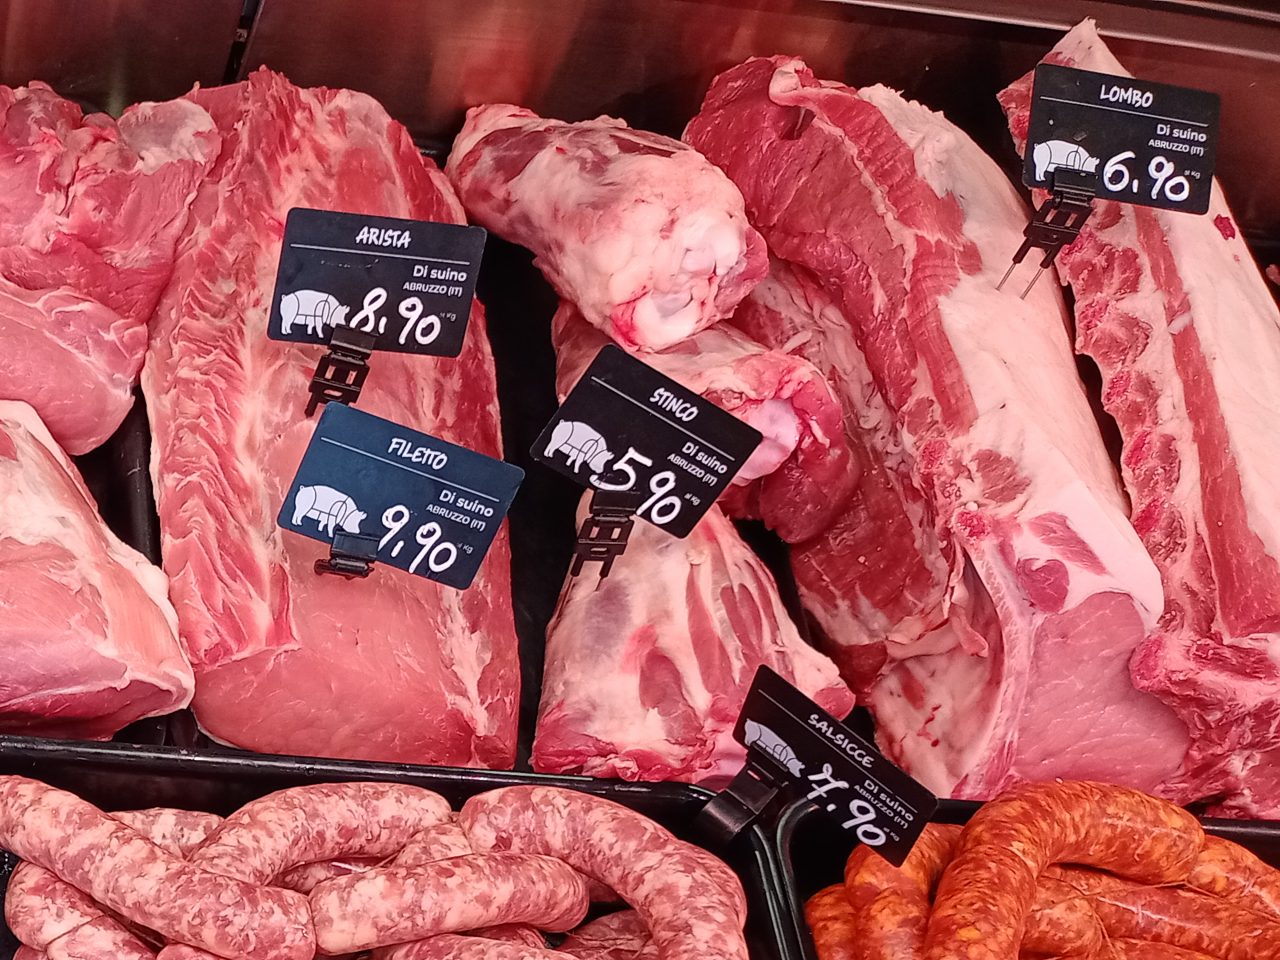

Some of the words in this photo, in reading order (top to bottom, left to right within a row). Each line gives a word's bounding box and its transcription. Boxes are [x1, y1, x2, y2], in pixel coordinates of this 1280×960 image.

[1099, 84, 1154, 108] LOMBO
[1148, 139, 1190, 153] ABRUZZO
[1190, 144, 1205, 157] (IT)
[1156, 124, 1171, 136] Di
[1172, 127, 1207, 143] suino
[355, 225, 412, 249] ARISTA
[413, 264, 428, 278] Di
[429, 266, 468, 282] suino
[402, 282, 448, 295] ABRUZZO
[448, 285, 463, 298] (IT)
[649, 387, 699, 423] STINCO
[387, 437, 448, 470] FILETTO
[682, 441, 701, 458] Di
[695, 450, 728, 475] suino
[667, 453, 704, 479] ABRUZZO
[702, 474, 718, 487] (IT)
[425, 504, 471, 526] ABRUZZO
[470, 518, 487, 532] (IT)
[439, 489, 457, 505] Di
[456, 494, 494, 518] suino
[807, 714, 876, 768] SALSICCE
[853, 784, 895, 817] ABRUZZO
[863, 780, 880, 795] Di
[879, 790, 915, 822] suino
